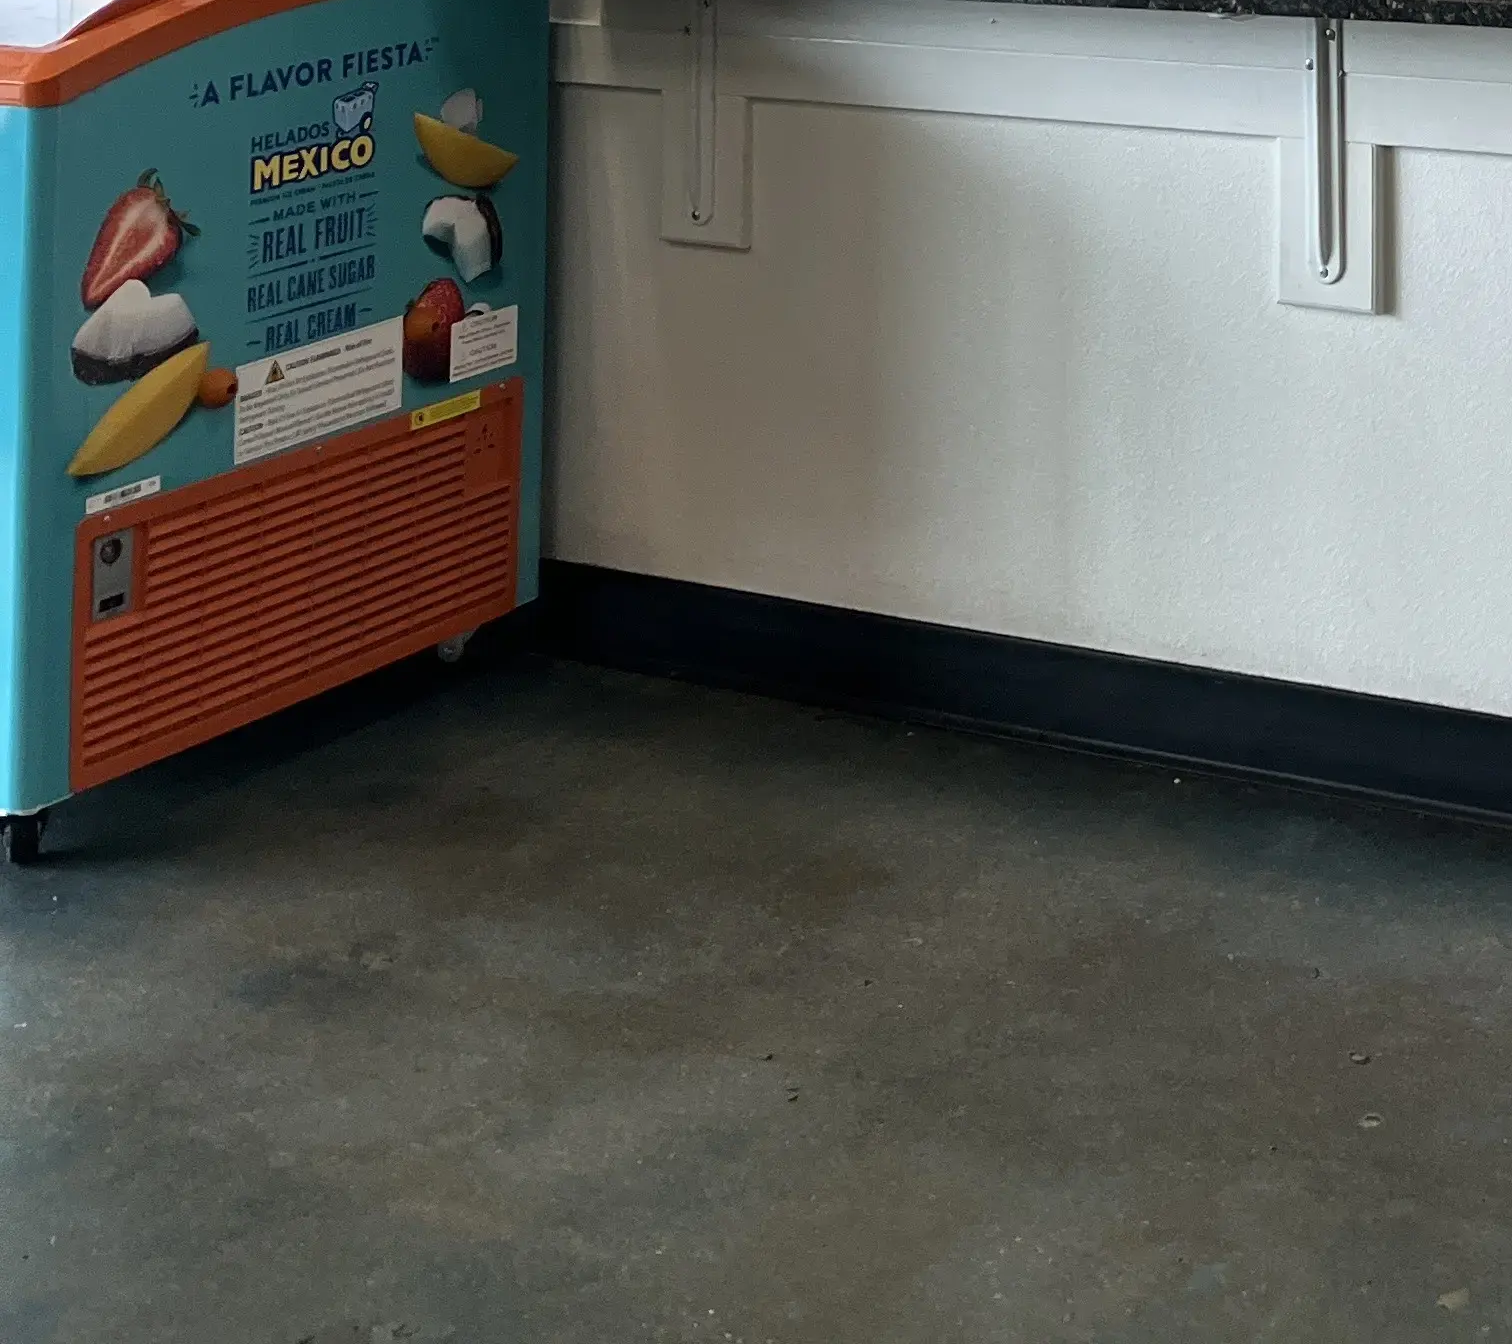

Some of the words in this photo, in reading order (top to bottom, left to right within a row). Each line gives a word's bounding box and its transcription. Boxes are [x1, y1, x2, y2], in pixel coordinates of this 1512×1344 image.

[199, 79, 221, 107] A
[229, 59, 334, 101] FLAVOR
[342, 41, 425, 79] FIESTA
[250, 121, 330, 154] HELADOS
[251, 132, 375, 193] MEXICO
[262, 224, 307, 264] REAL
[315, 207, 366, 250] FRUIT
[273, 201, 316, 222] MADE
[320, 192, 357, 210] WITH
[247, 281, 283, 313] REAL
[287, 267, 327, 303] CANE
[328, 255, 376, 291] SUGAR
[265, 319, 301, 353] REAL
[307, 302, 357, 341] CREAM
